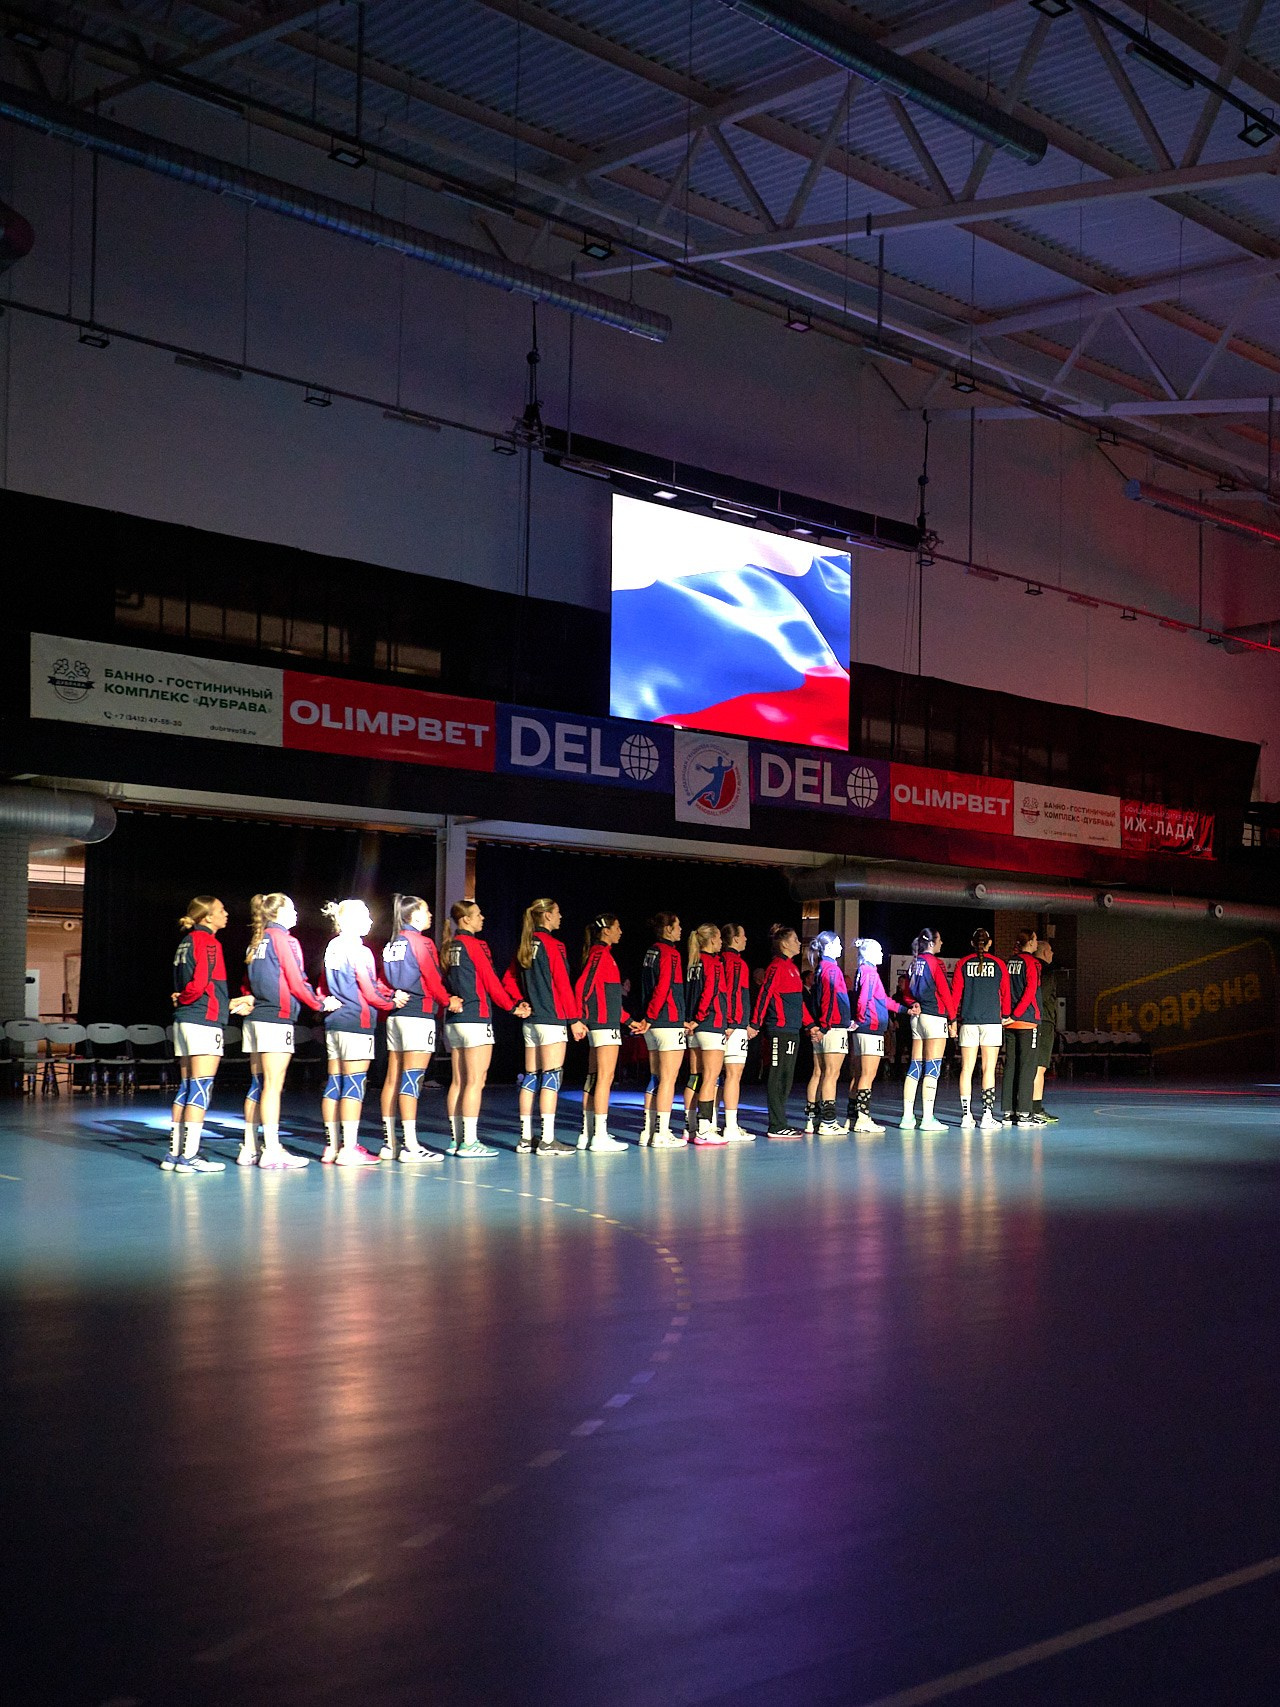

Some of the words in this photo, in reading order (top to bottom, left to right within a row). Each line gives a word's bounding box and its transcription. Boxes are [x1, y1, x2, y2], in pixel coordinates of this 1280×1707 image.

[104, 668, 155, 684] БАННО
[166, 676, 273, 700] ГОСТИНИЧНЫЙ
[104, 683, 190, 703] КОМПЛЕКС
[289, 699, 490, 747] OLIMPBET
[893, 784, 1011, 816] OLIMPBET
[1124, 816, 1195, 841] ИЖ-ЛАДА
[1106, 971, 1262, 1033] #оарена
[286, 1031, 292, 1046] 8
